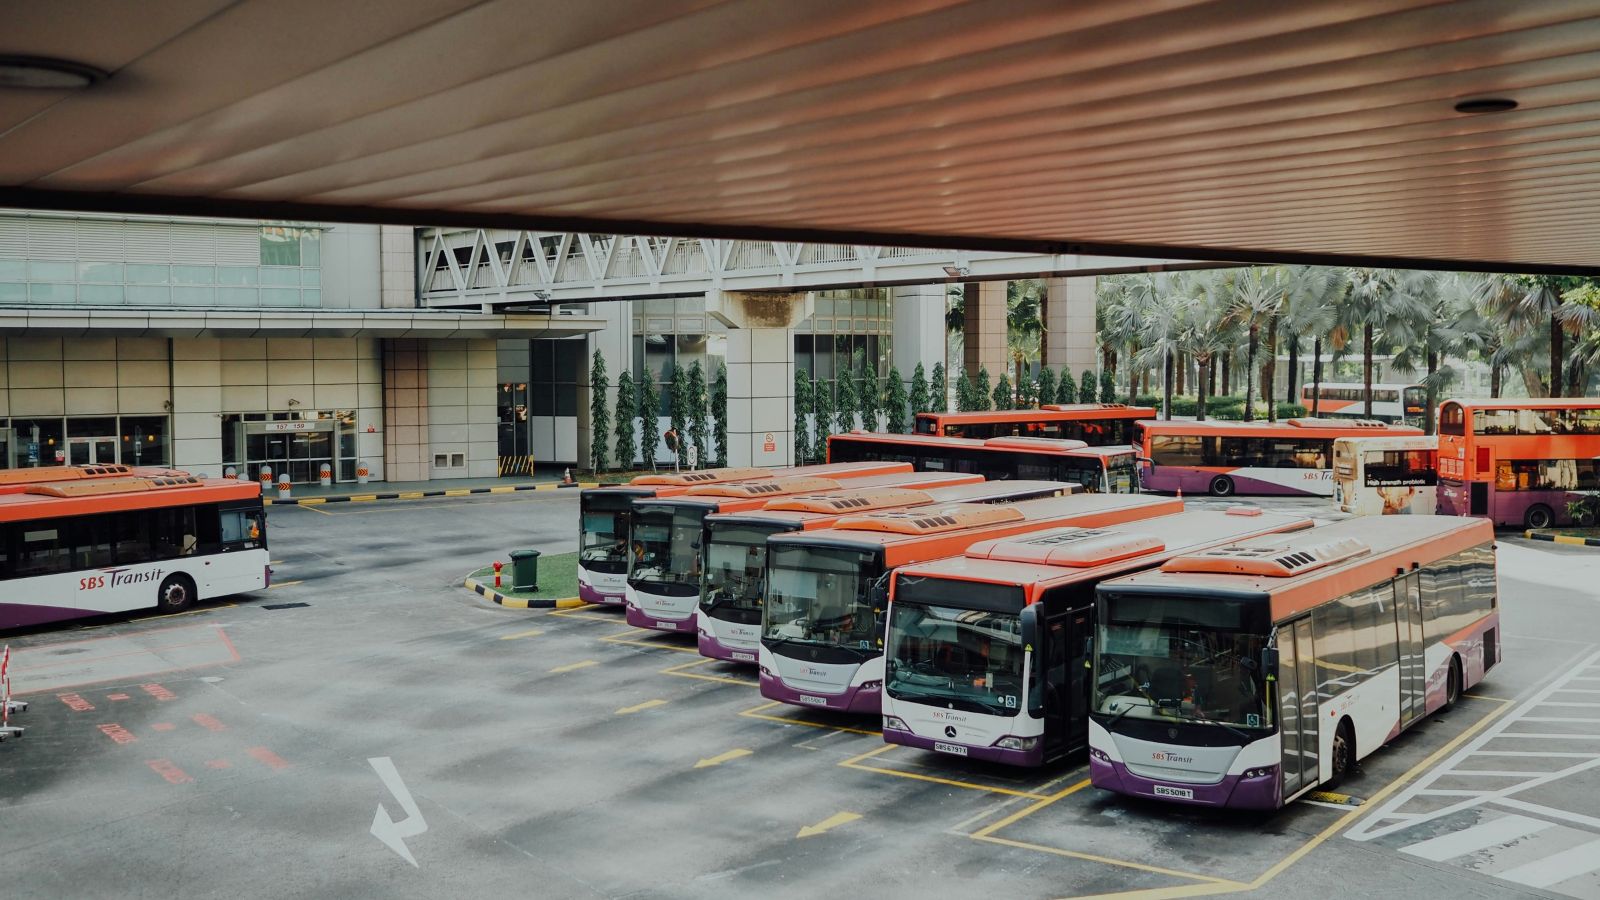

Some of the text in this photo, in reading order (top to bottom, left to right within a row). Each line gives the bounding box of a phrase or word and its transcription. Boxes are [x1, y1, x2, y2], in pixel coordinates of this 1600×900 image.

[1303, 472, 1319, 480] SBS
[79, 568, 166, 591] SBS Transit
[944, 712, 967, 722] Transit
[935, 744, 967, 754] SBS6797X
[1152, 752, 1193, 764] SBS Transit
